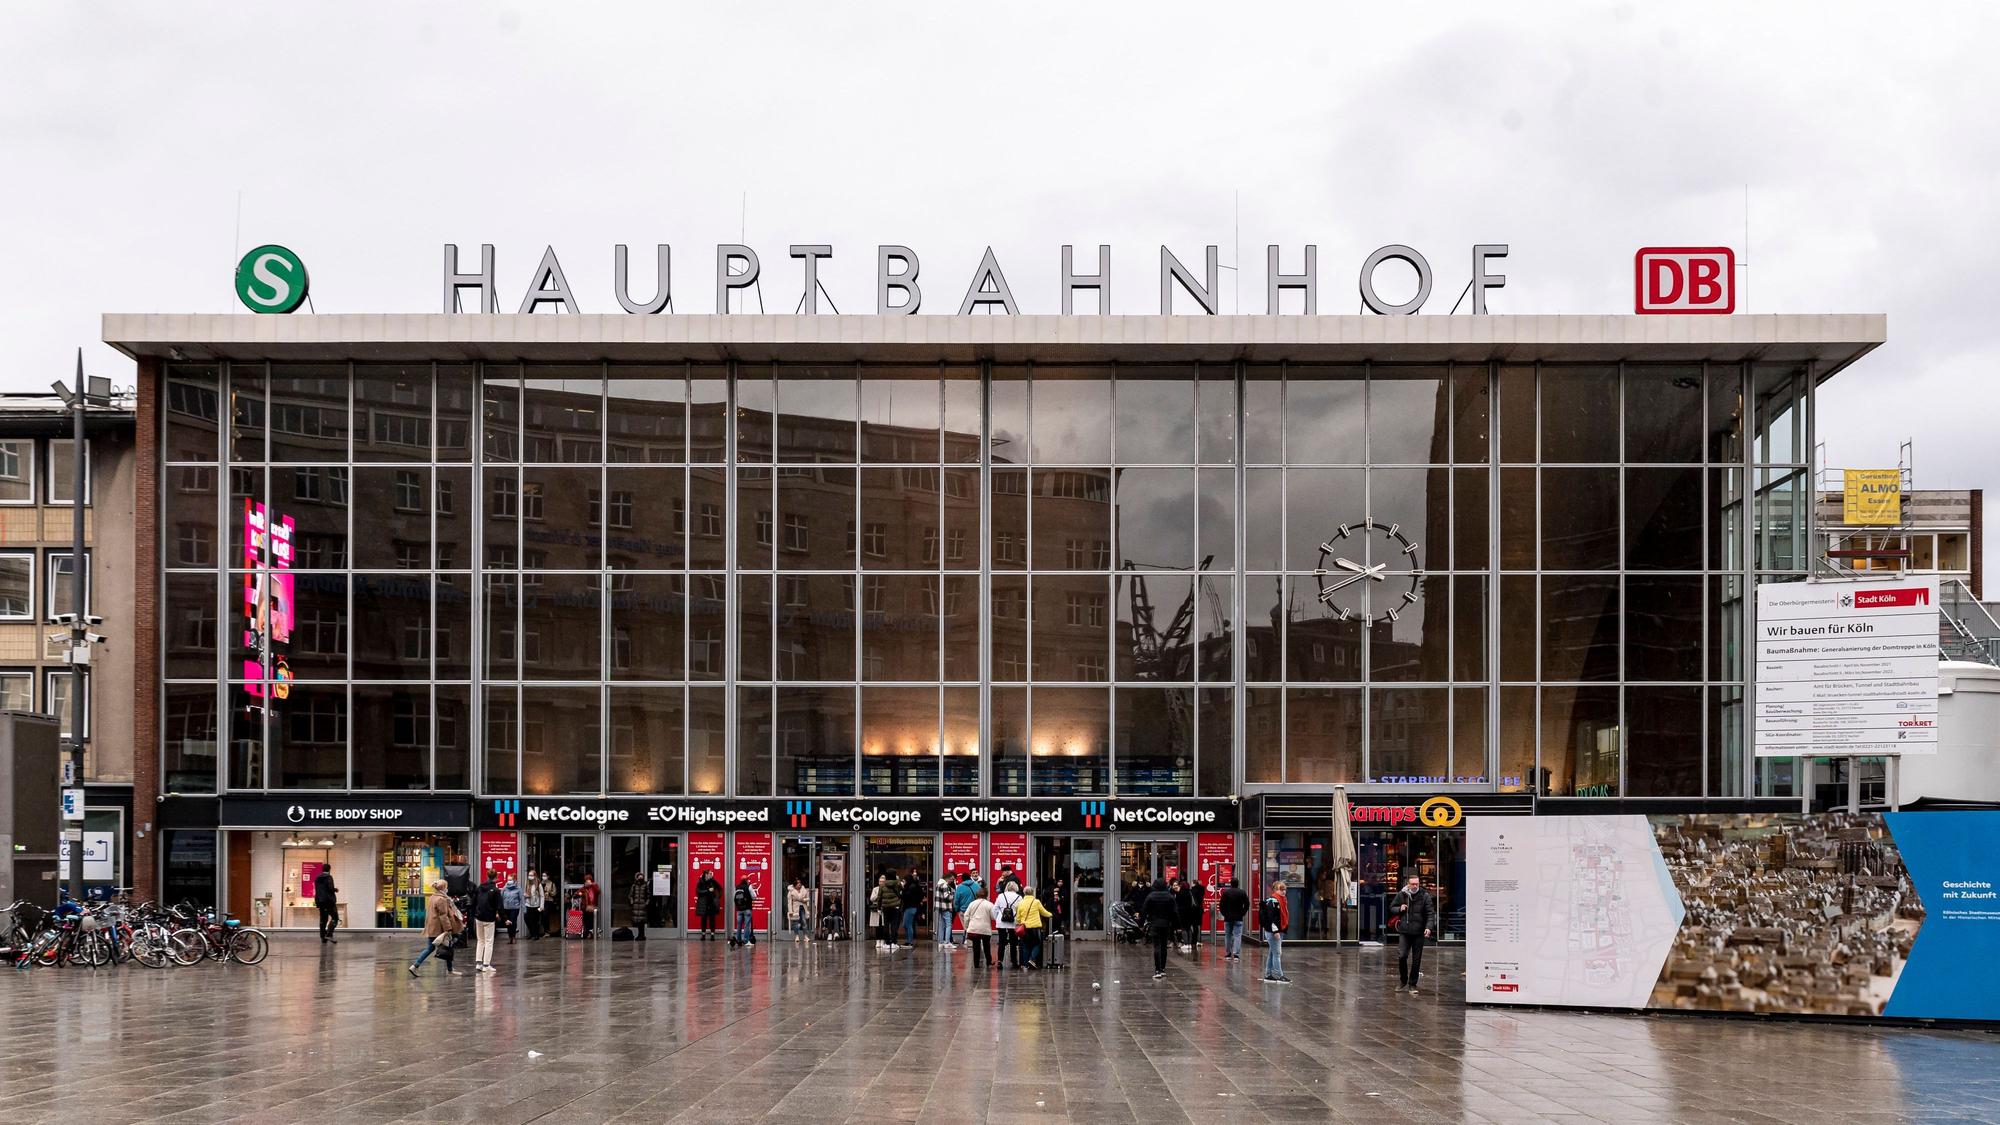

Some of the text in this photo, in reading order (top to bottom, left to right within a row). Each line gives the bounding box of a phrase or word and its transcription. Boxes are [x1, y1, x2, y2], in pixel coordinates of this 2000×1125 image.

[247, 253, 293, 307] S
[443, 243, 1509, 315] HAUPTBAHNHOF
[1648, 258, 1722, 305] DB
[1861, 484, 1899, 493] ALMO
[1857, 594, 1897, 604] Stadt Köln
[1767, 622, 1874, 636] Wir bauen für Köln
[1766, 647, 1820, 655] Baumaßnahme:
[1381, 776, 1465, 784] STARBUCS
[309, 808, 403, 820] THE BODY SHOP
[527, 806, 629, 824] NetCologne
[678, 806, 769, 826] Highspeed
[819, 806, 921, 825] NetCologne
[971, 806, 1063, 826] Highspeed
[1113, 806, 1216, 825] NetCologne
